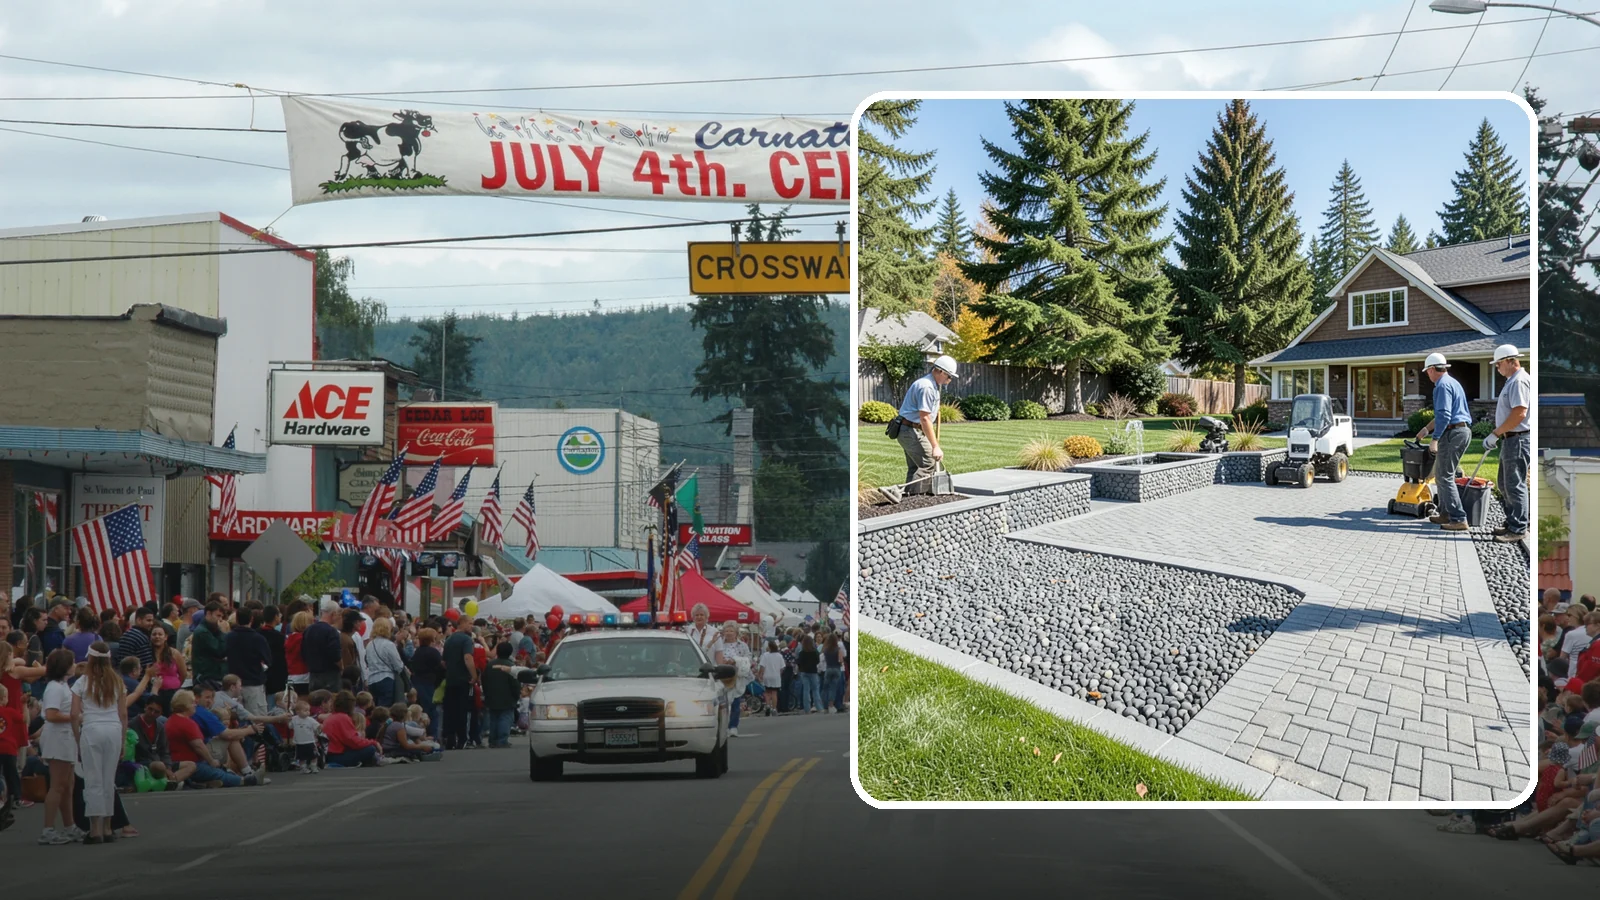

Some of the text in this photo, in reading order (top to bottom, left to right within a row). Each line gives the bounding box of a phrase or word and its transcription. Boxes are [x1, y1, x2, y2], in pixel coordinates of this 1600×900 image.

[695, 121, 850, 150] Carnat
[481, 141, 604, 193] JULY
[633, 149, 746, 198] 4th.
[697, 254, 850, 280] CROSSWA
[283, 380, 373, 420] ACE
[406, 409, 485, 421] CEDAR LOG
[283, 421, 370, 436] Hardware
[416, 428, 477, 446] Coca-Cola
[353, 467, 385, 480] Simpl
[83, 485, 155, 495] St. Vincent de Paul
[213, 516, 330, 535] HARDARE
[688, 527, 741, 535] CRNATION
[699, 535, 730, 543] GLASS
